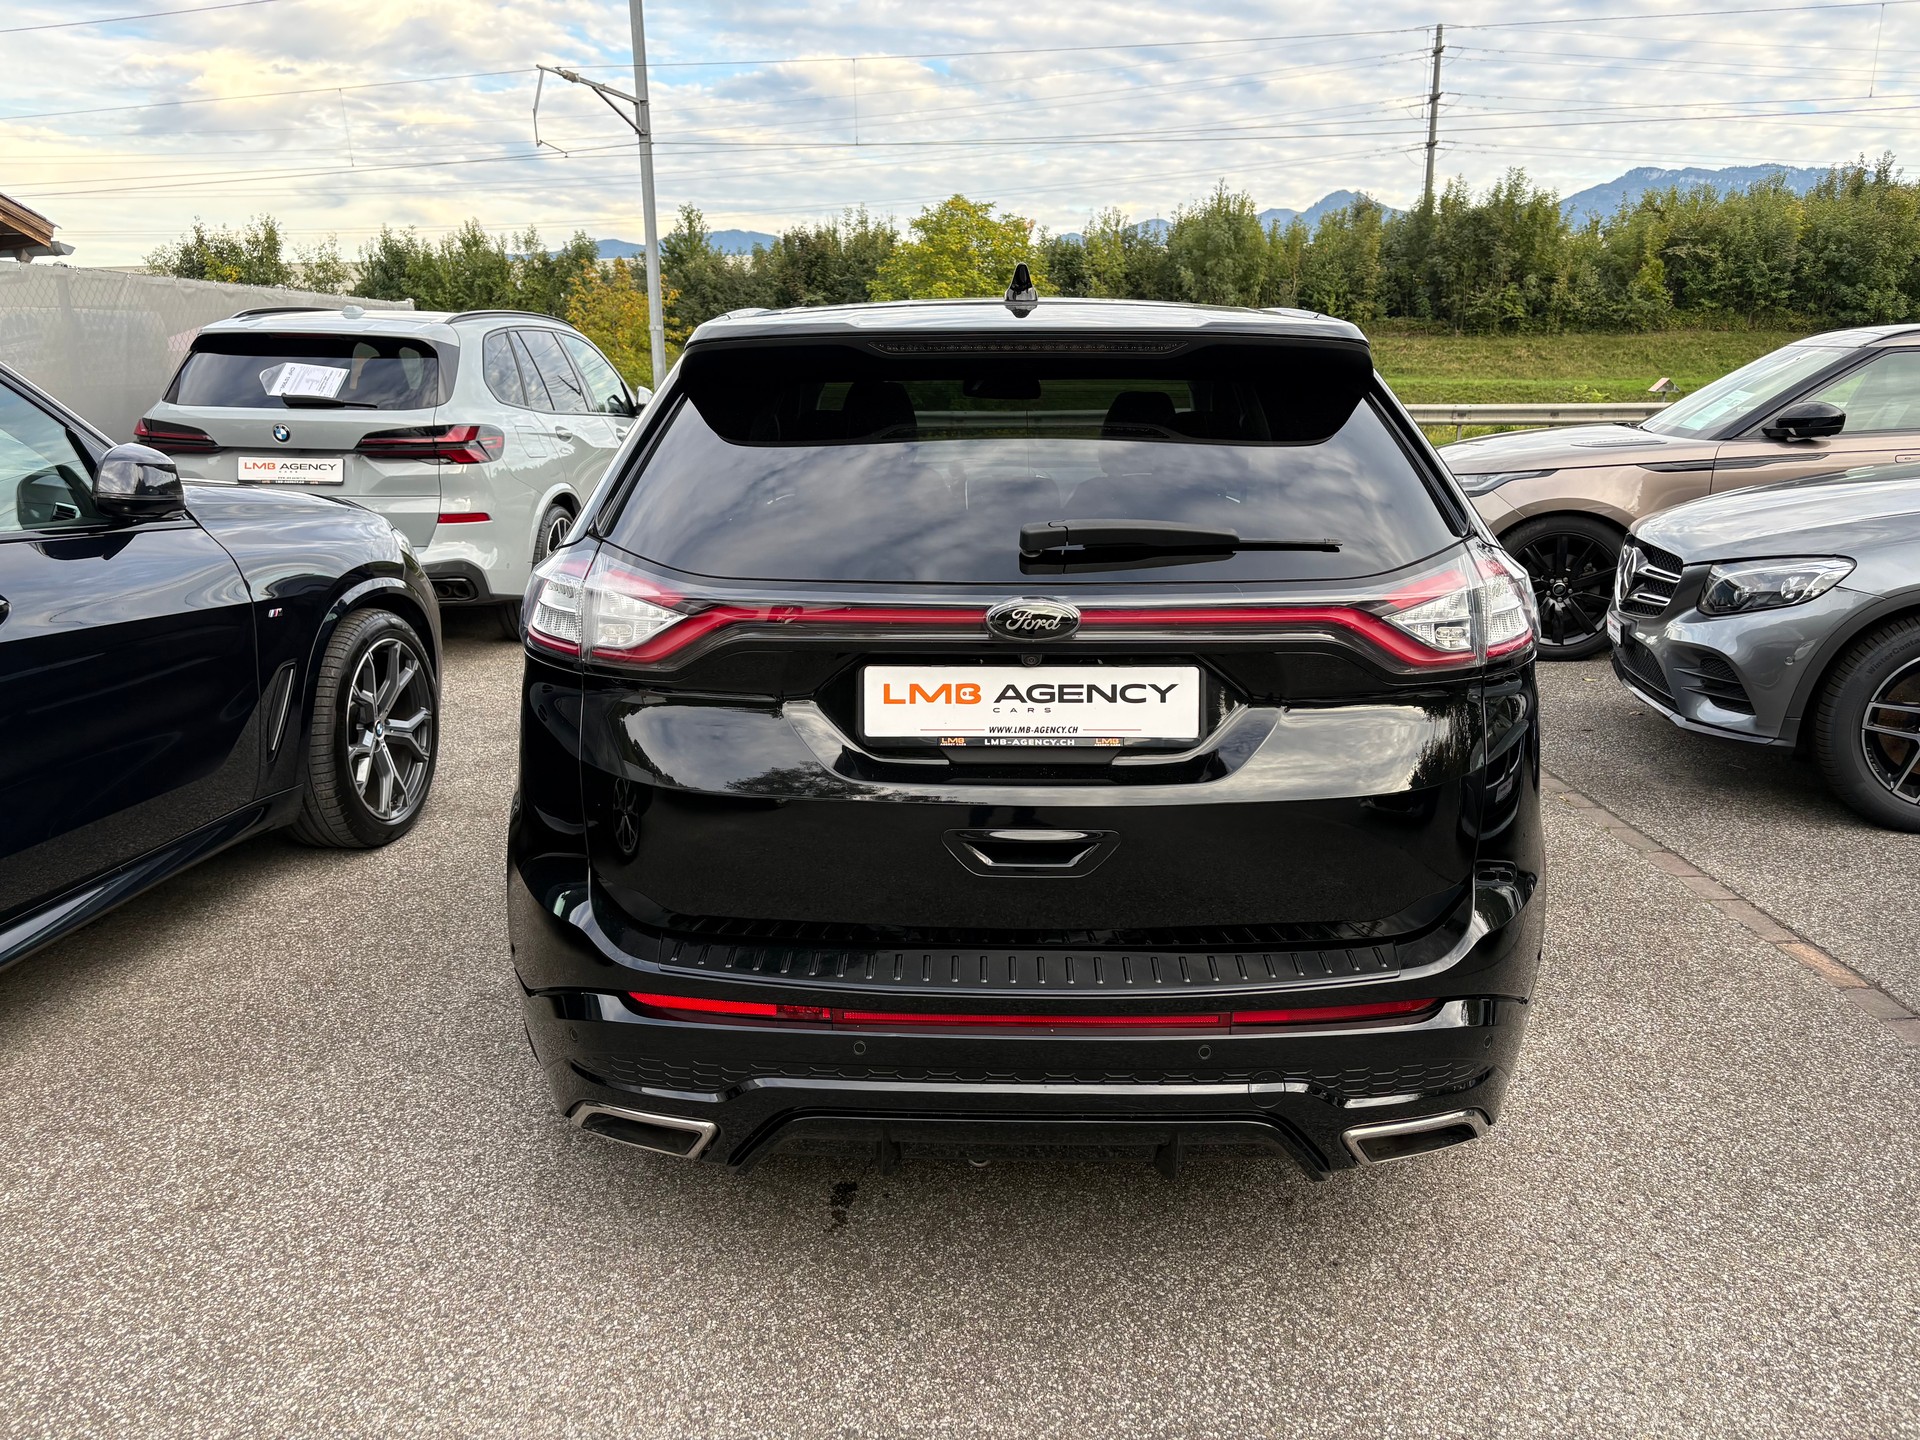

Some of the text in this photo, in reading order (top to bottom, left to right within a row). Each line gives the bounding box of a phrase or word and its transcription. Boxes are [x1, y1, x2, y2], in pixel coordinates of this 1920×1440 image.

[244, 462, 337, 471] LMB AGENCY
[1005, 608, 1061, 631] Ford
[883, 683, 1179, 705] LMB AGENCY
[988, 726, 1079, 735] WWW.LMB-AGENCY.CH
[984, 738, 1075, 746] LMB-AGENCY.CH
